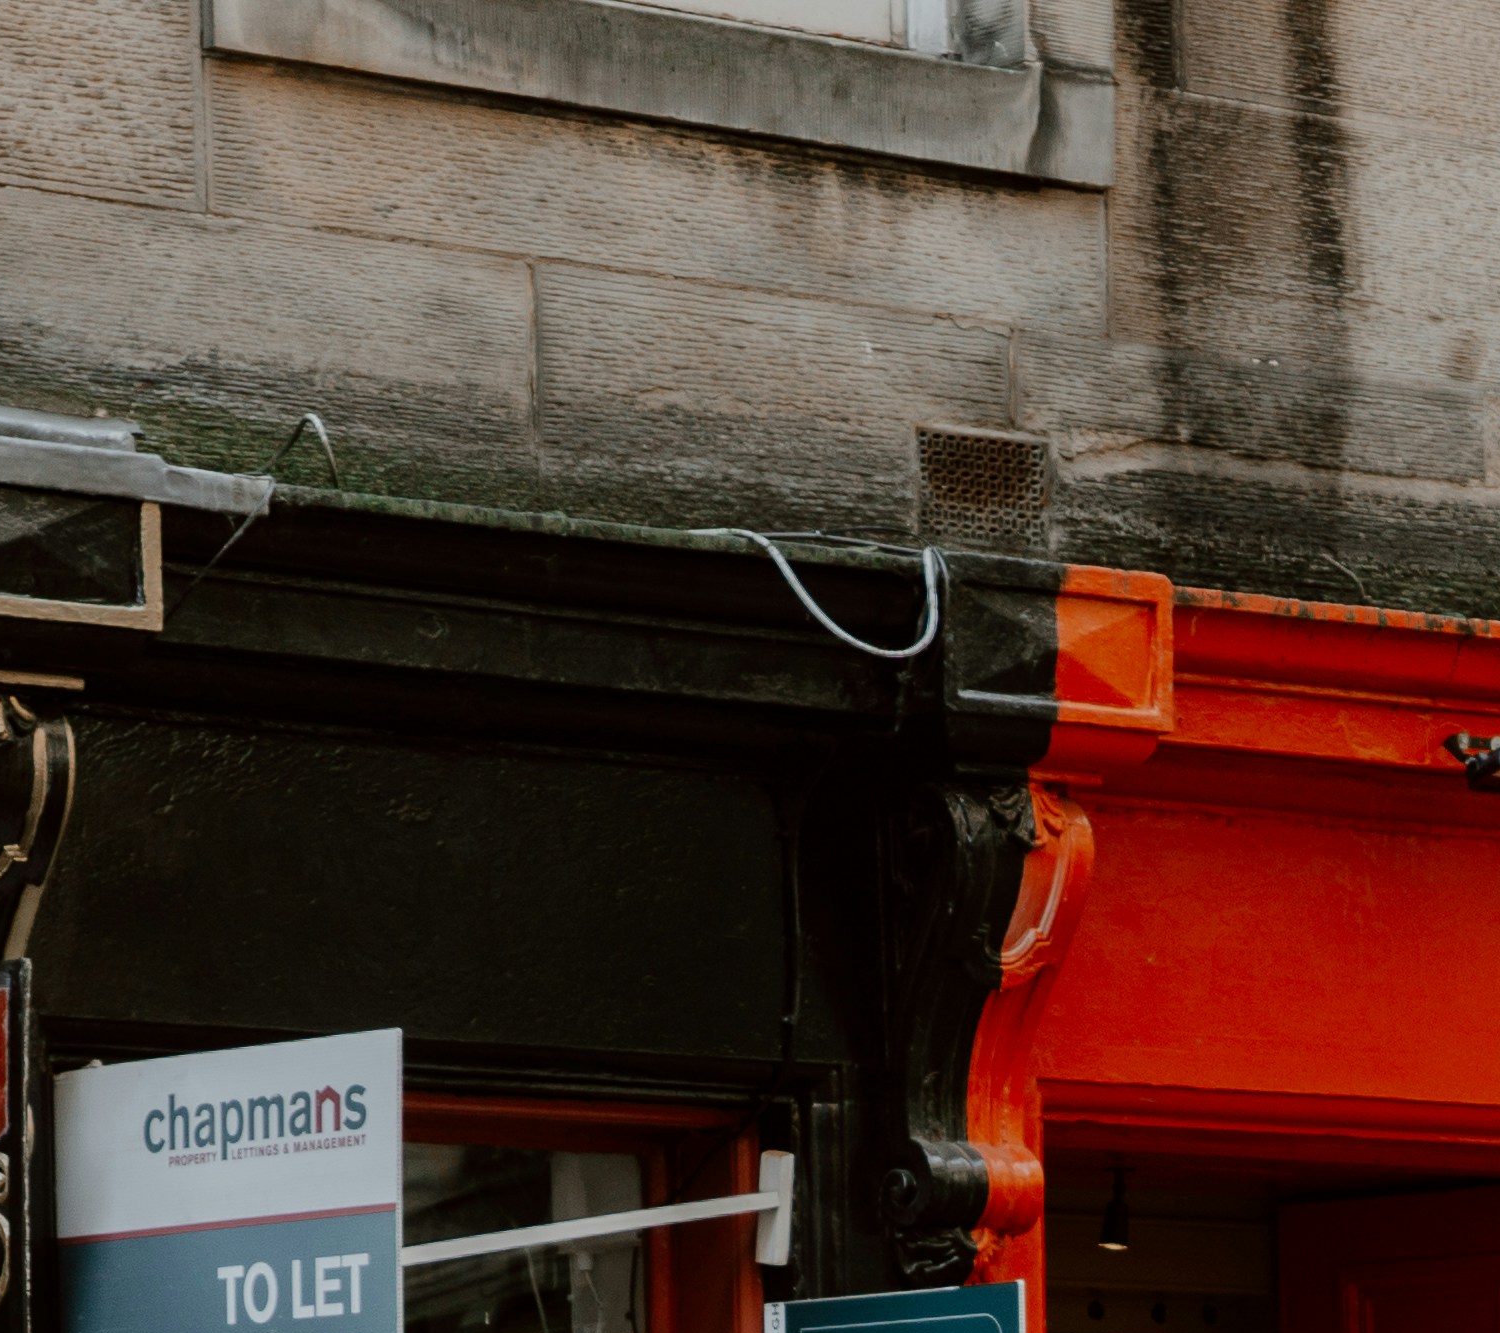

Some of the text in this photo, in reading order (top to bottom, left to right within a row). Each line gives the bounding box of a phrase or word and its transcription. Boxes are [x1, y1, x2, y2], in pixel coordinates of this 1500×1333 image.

[143, 1084, 367, 1160] chapmans
[168, 1134, 367, 1168] PROPERTY LETTINGS & MANAGEMENT
[217, 1253, 370, 1325] TO LET
